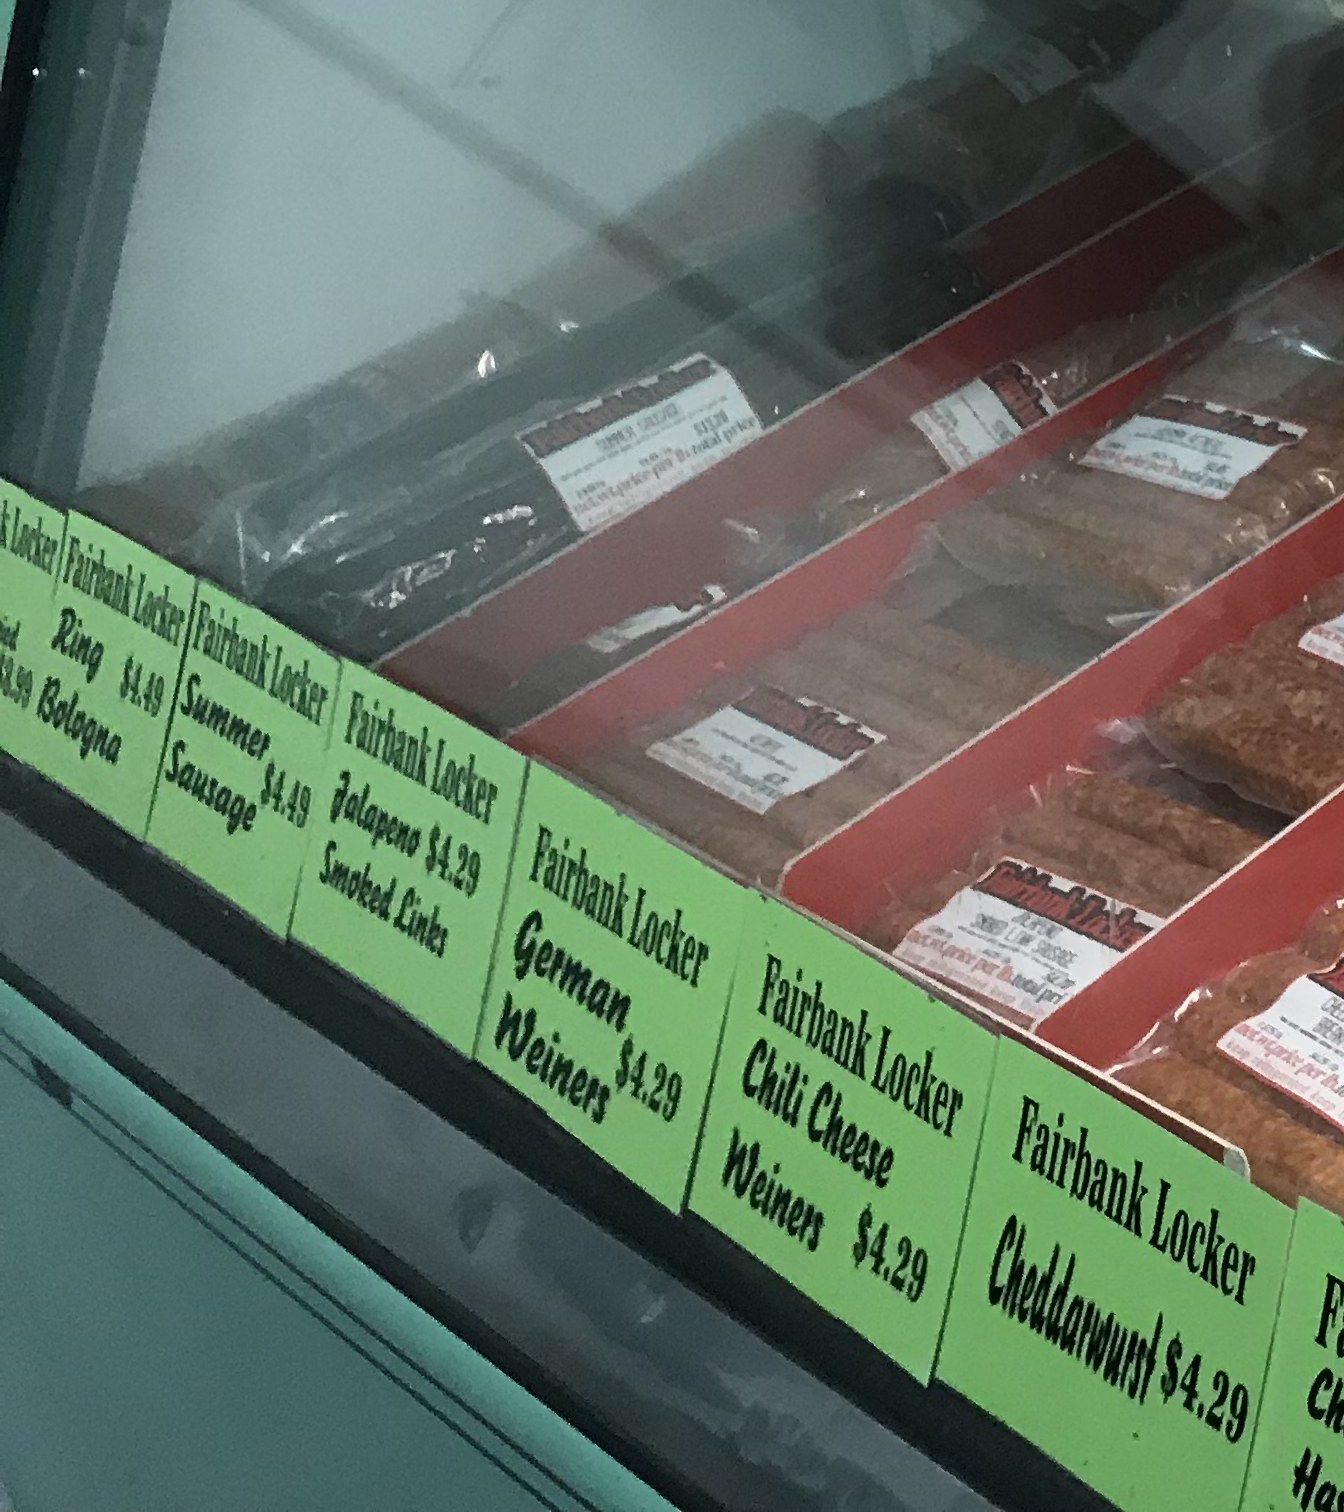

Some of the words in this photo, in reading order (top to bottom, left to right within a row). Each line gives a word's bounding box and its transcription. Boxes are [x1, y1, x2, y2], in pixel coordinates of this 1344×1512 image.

[52, 607, 105, 683] Ring
[120, 653, 165, 718] $4.49
[37, 677, 122, 766] Bologna
[180, 674, 271, 760] Summer
[345, 690, 432, 787] Fairbank
[431, 739, 498, 825] Locker
[165, 739, 258, 834] Sausage
[260, 760, 312, 828] $4.49
[330, 770, 422, 858] Jalapeno
[425, 822, 481, 898] $4.29
[320, 840, 396, 922] Smoked
[393, 888, 449, 958] Links
[529, 824, 630, 939] Fairbank
[629, 888, 710, 988] Locker
[513, 910, 632, 1033] German
[495, 992, 613, 1125] Weiners
[615, 1034, 683, 1122] $4.29
[757, 953, 873, 1083] Fairbank
[873, 1025, 964, 1138] Locker
[743, 1038, 809, 1128] Chili
[808, 1082, 895, 1188] Cheese
[722, 1126, 825, 1252] Weiners
[852, 1203, 929, 1303] $4.29
[1011, 1095, 1147, 1244] Fairbank
[1149, 1180, 1256, 1306] Locker
[986, 1214, 1164, 1406] Cheddarwurst
[1160, 1332, 1249, 1444] $4.29
